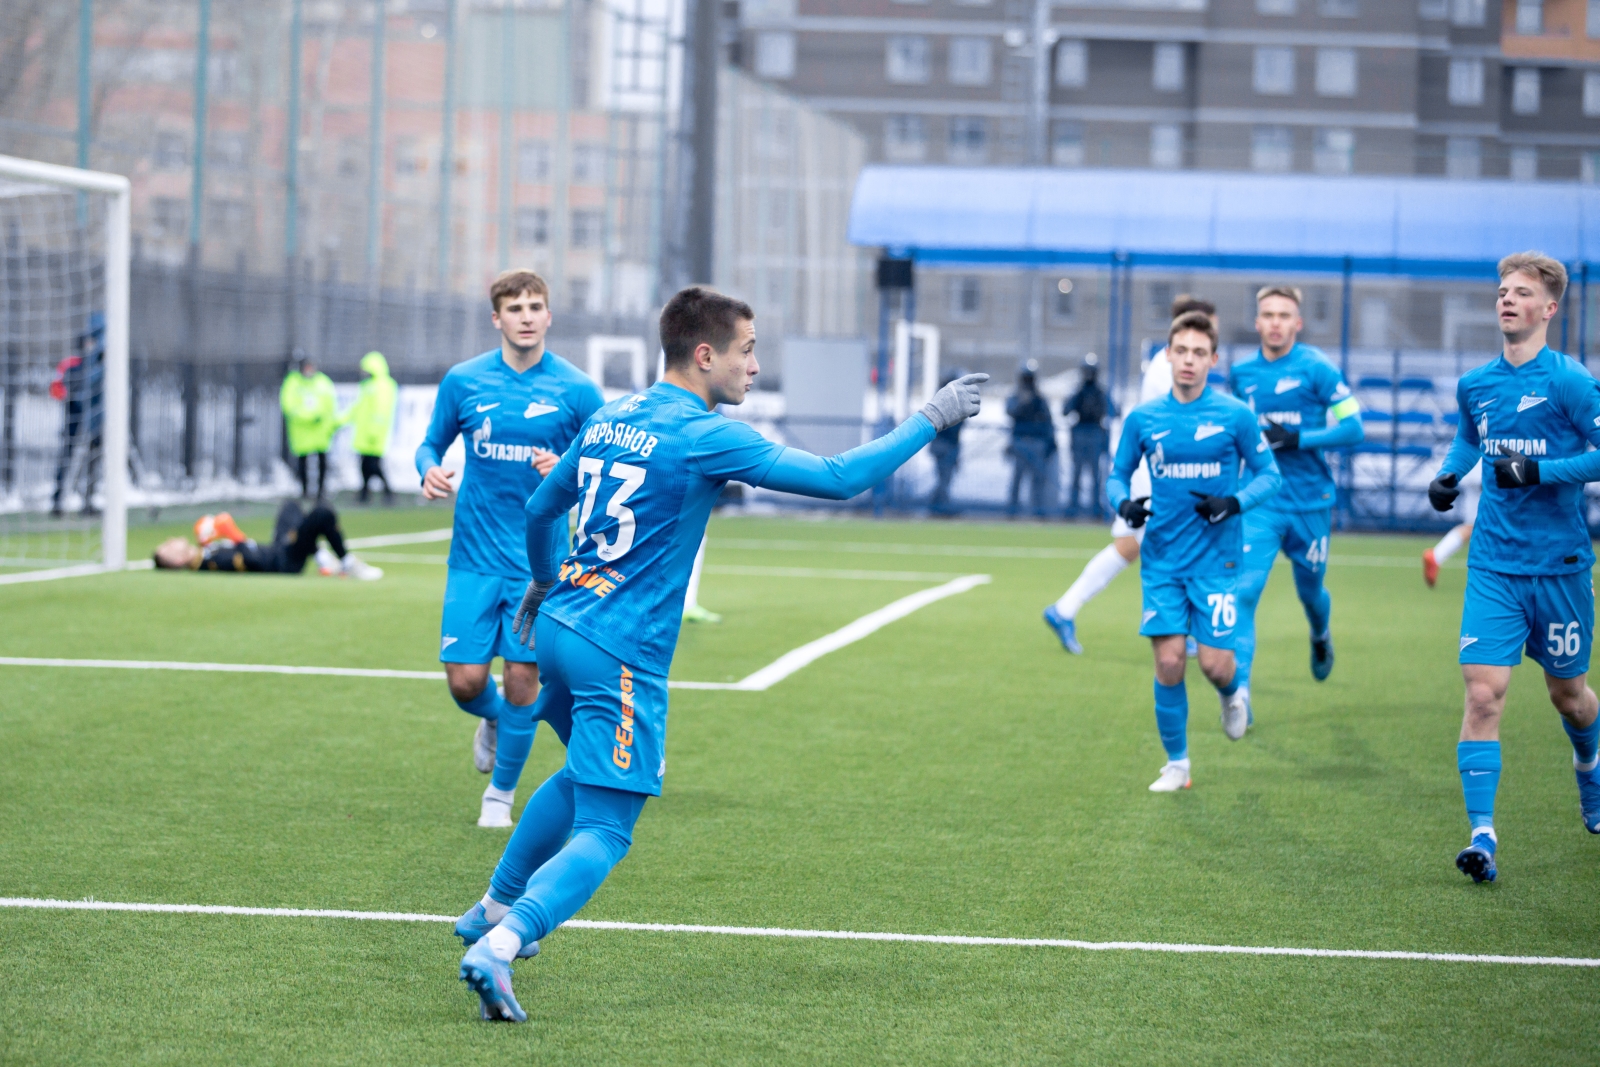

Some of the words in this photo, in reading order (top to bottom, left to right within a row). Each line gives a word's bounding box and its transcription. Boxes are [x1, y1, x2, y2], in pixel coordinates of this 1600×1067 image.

[491, 443, 553, 463] ГАЗПР
[1167, 461, 1221, 479] ГАЗПРОМ
[571, 456, 647, 563] 73
[1207, 592, 1237, 628] 76
[1547, 620, 1580, 657] 56
